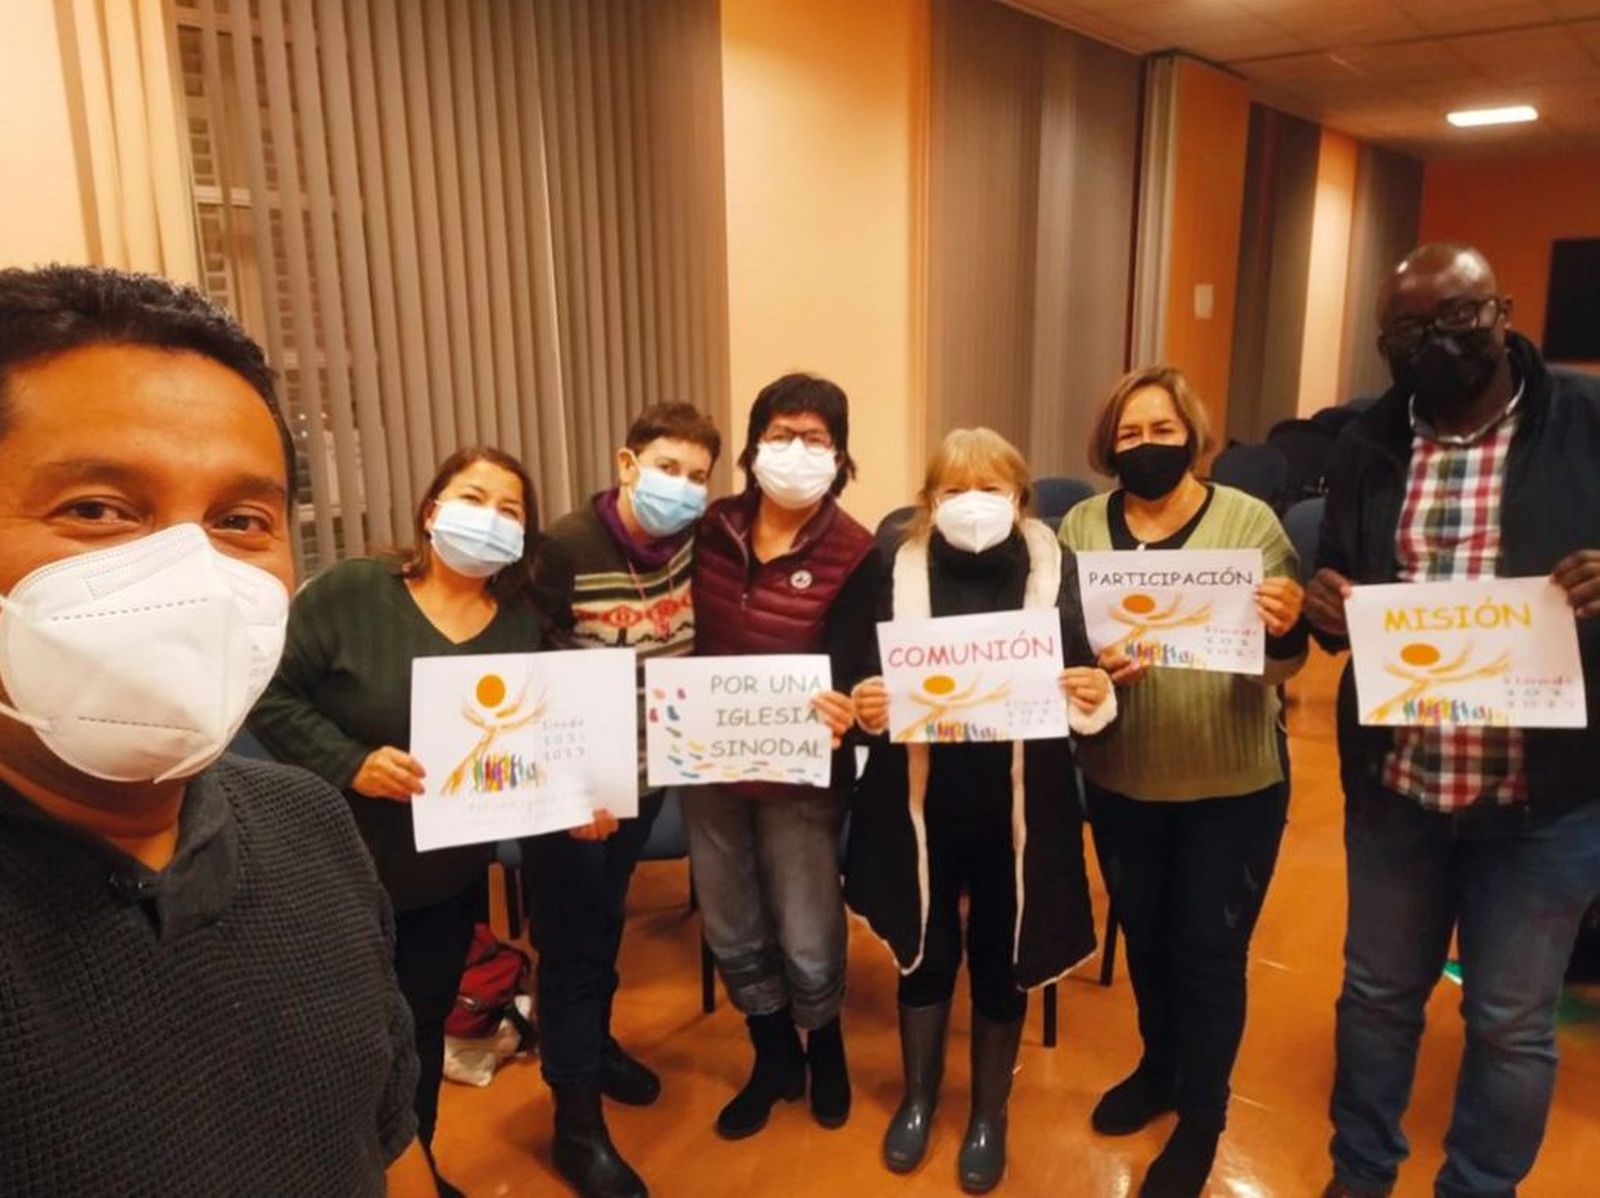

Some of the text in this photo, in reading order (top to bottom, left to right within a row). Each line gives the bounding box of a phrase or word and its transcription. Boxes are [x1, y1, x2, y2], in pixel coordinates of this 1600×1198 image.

[1088, 566, 1253, 586] PARTICIPACIÓN
[1383, 595, 1532, 631] MISIÓN
[888, 630, 1054, 668] COMUNIÓN
[710, 674, 822, 694] POR UNA
[715, 706, 820, 727] IGLESIA
[710, 737, 823, 758] SINODAL
